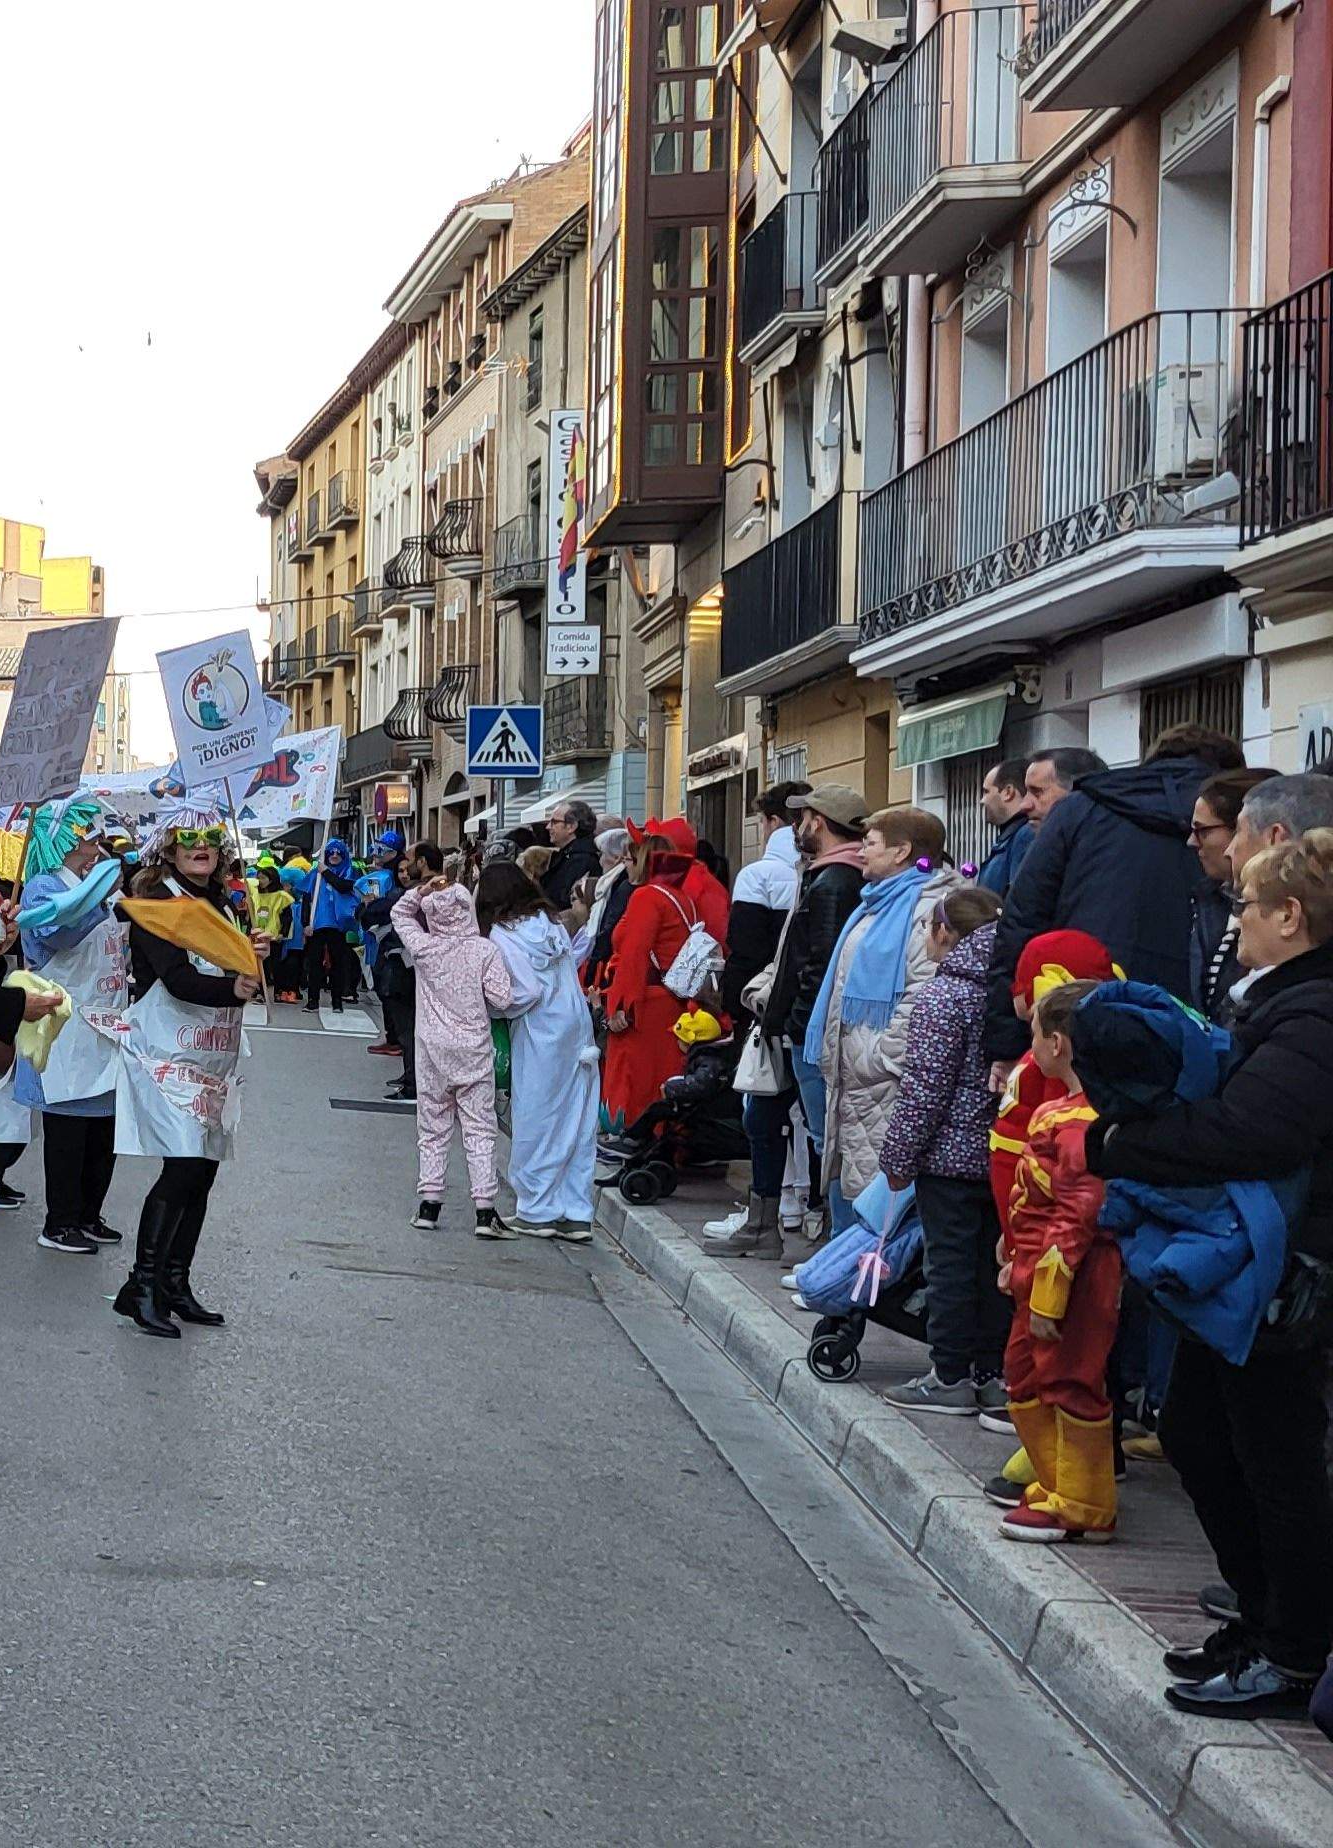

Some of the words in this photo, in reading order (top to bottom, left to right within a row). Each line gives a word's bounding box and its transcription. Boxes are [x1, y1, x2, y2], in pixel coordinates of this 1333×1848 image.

[557, 630, 591, 643] Comida
[550, 643, 599, 656] Tradicional
[192, 743, 208, 752] POR
[209, 739, 221, 748] UN
[222, 726, 259, 744] CONVENIO
[198, 734, 256, 766] ¡DIGNO!
